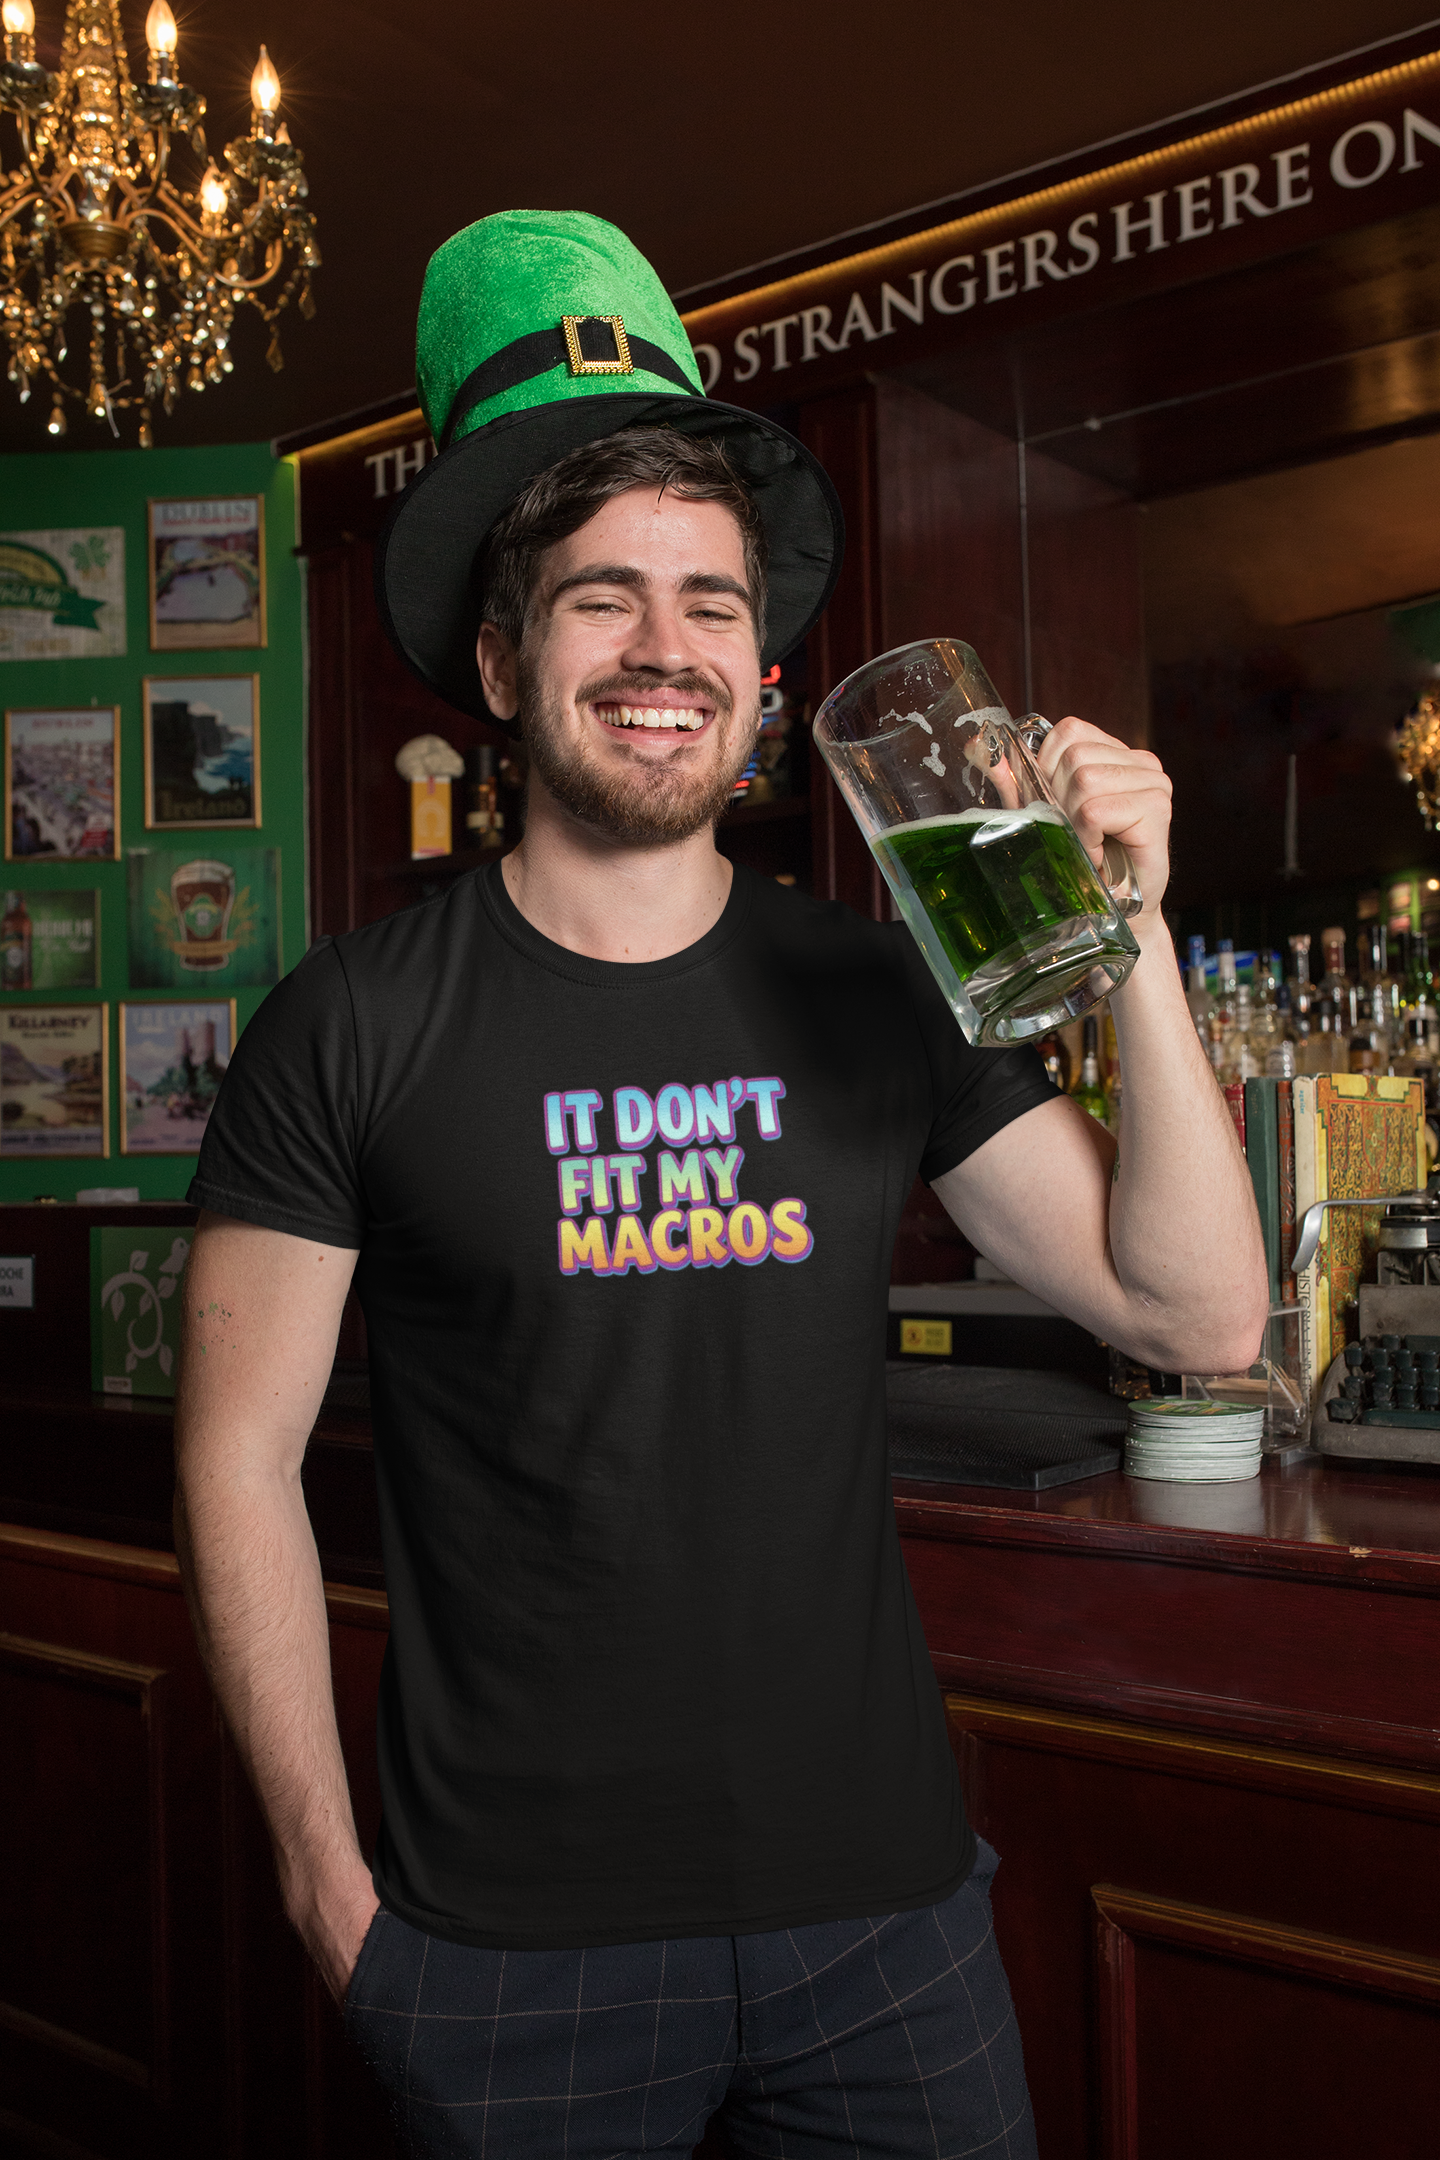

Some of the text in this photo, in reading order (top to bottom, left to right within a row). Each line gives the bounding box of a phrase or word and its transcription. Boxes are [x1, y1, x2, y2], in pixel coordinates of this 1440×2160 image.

[364, 436, 438, 499] TH
[734, 213, 1101, 382] STRANGERS
[1109, 142, 1313, 264] HERE
[8, 1013, 92, 1029] KILLARNEY
[544, 1076, 786, 1154] IT DON'T
[558, 1145, 744, 1216] FIT MY
[558, 1197, 814, 1276] MACROS
